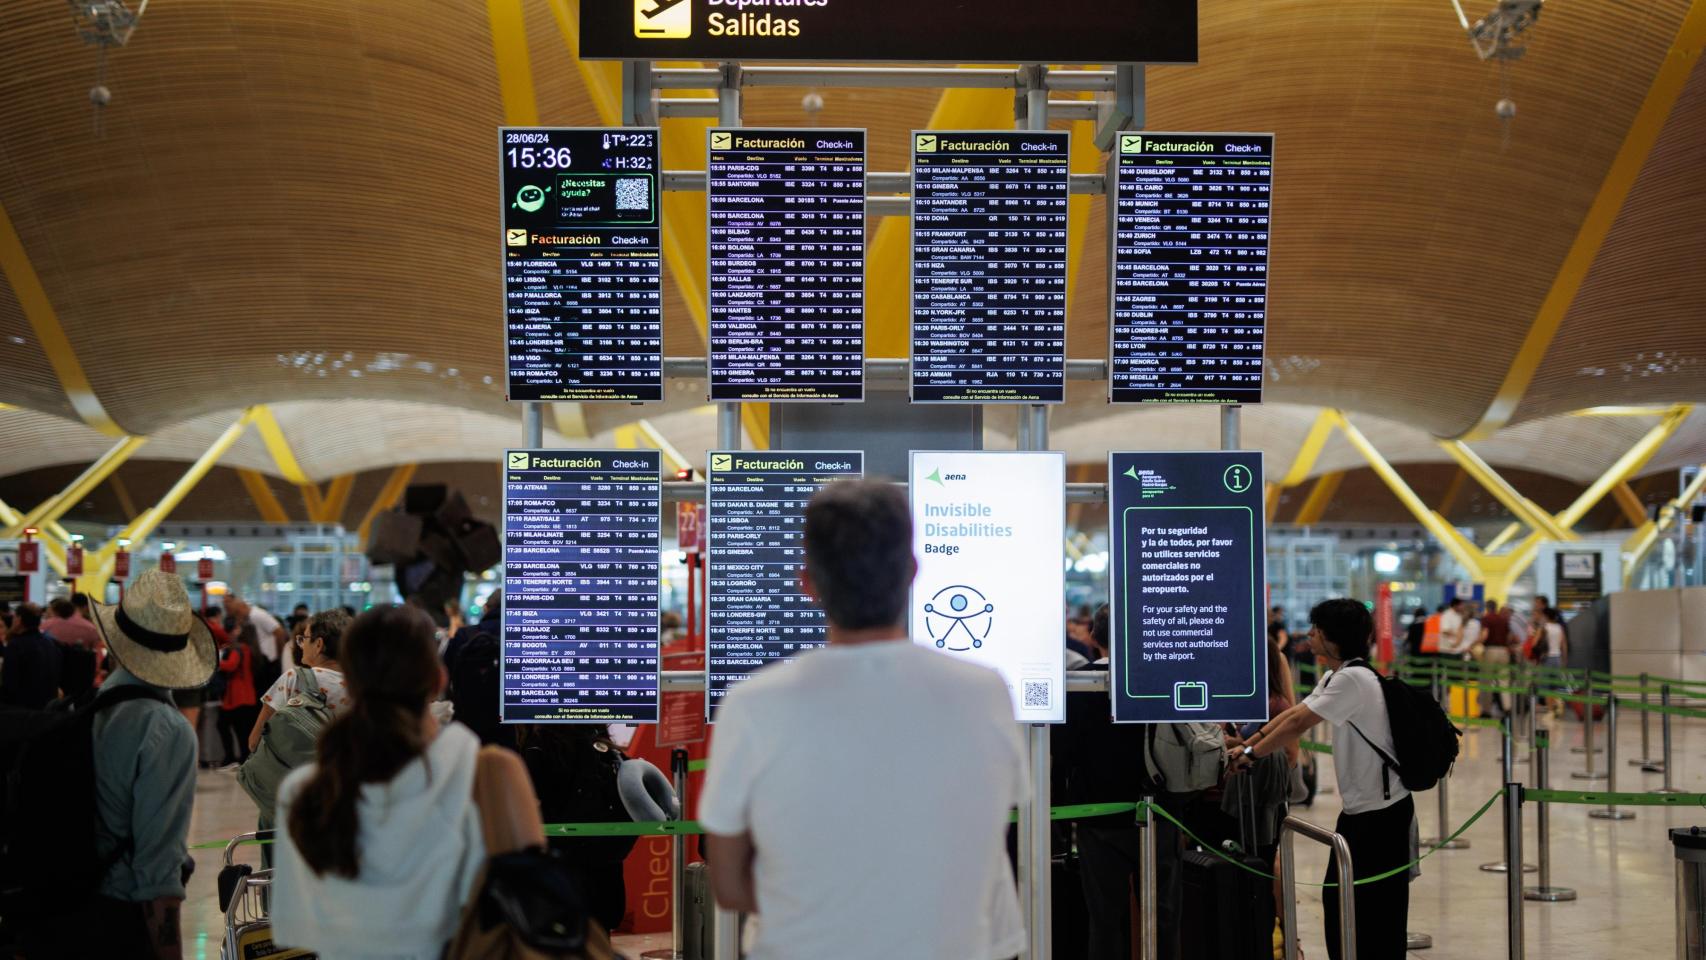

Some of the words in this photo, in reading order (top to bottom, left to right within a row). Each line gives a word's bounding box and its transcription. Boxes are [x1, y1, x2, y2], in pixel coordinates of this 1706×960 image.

[707, 12, 800, 37] Salidas
[506, 133, 549, 144] 28/06/24
[735, 137, 805, 149] Facturación
[816, 139, 853, 149] Check-in
[940, 140, 1010, 151] Facturación
[1021, 142, 1058, 151] Check-in
[1145, 141, 1214, 152] Facturación
[1225, 143, 1262, 153] Check-in
[508, 147, 572, 169] 15:36
[561, 179, 606, 188] ¿Necesitas
[561, 189, 591, 198] ayuda?
[531, 234, 601, 245] Facturación
[611, 235, 649, 245] Check-in
[532, 457, 601, 468] Facturación
[612, 459, 649, 469] Check-in
[736, 459, 804, 470] Facturación
[814, 461, 851, 470] Check-in
[944, 472, 967, 481] aena
[924, 503, 992, 517] Invisible
[924, 522, 1013, 537] Disabilities
[1141, 527, 1155, 535] Por
[1157, 527, 1166, 535] tu
[1168, 527, 1208, 536] seguridad
[1148, 539, 1156, 547] la
[1158, 538, 1168, 547] de
[1170, 539, 1195, 548] todos,
[1196, 540, 1209, 548] por
[1211, 538, 1233, 547] favor
[924, 543, 960, 556] Badge
[1154, 550, 1183, 558] utilices
[1184, 550, 1220, 558] servicios
[1142, 562, 1189, 570] comerciales
[1142, 573, 1189, 582] autorizados
[1191, 575, 1204, 583] por
[1205, 573, 1214, 581] el
[1142, 585, 1189, 595] aeropuerto.
[1156, 607, 1173, 615] your
[1174, 605, 1198, 614] safety
[1199, 605, 1213, 613] and
[1215, 605, 1228, 613] the
[1142, 617, 1166, 626] safety
[1167, 617, 1176, 625] of
[1177, 617, 1188, 625] all,
[1189, 617, 1213, 626] please
[1215, 616, 1225, 624] do
[1143, 629, 1156, 637] not
[1172, 628, 1213, 636] commercial
[1143, 640, 1174, 648] services
[1189, 640, 1229, 648] authorised
[1143, 652, 1153, 661] by
[1154, 652, 1167, 660] the
[1168, 652, 1196, 661] airport.
[642, 835, 670, 918] Chec
